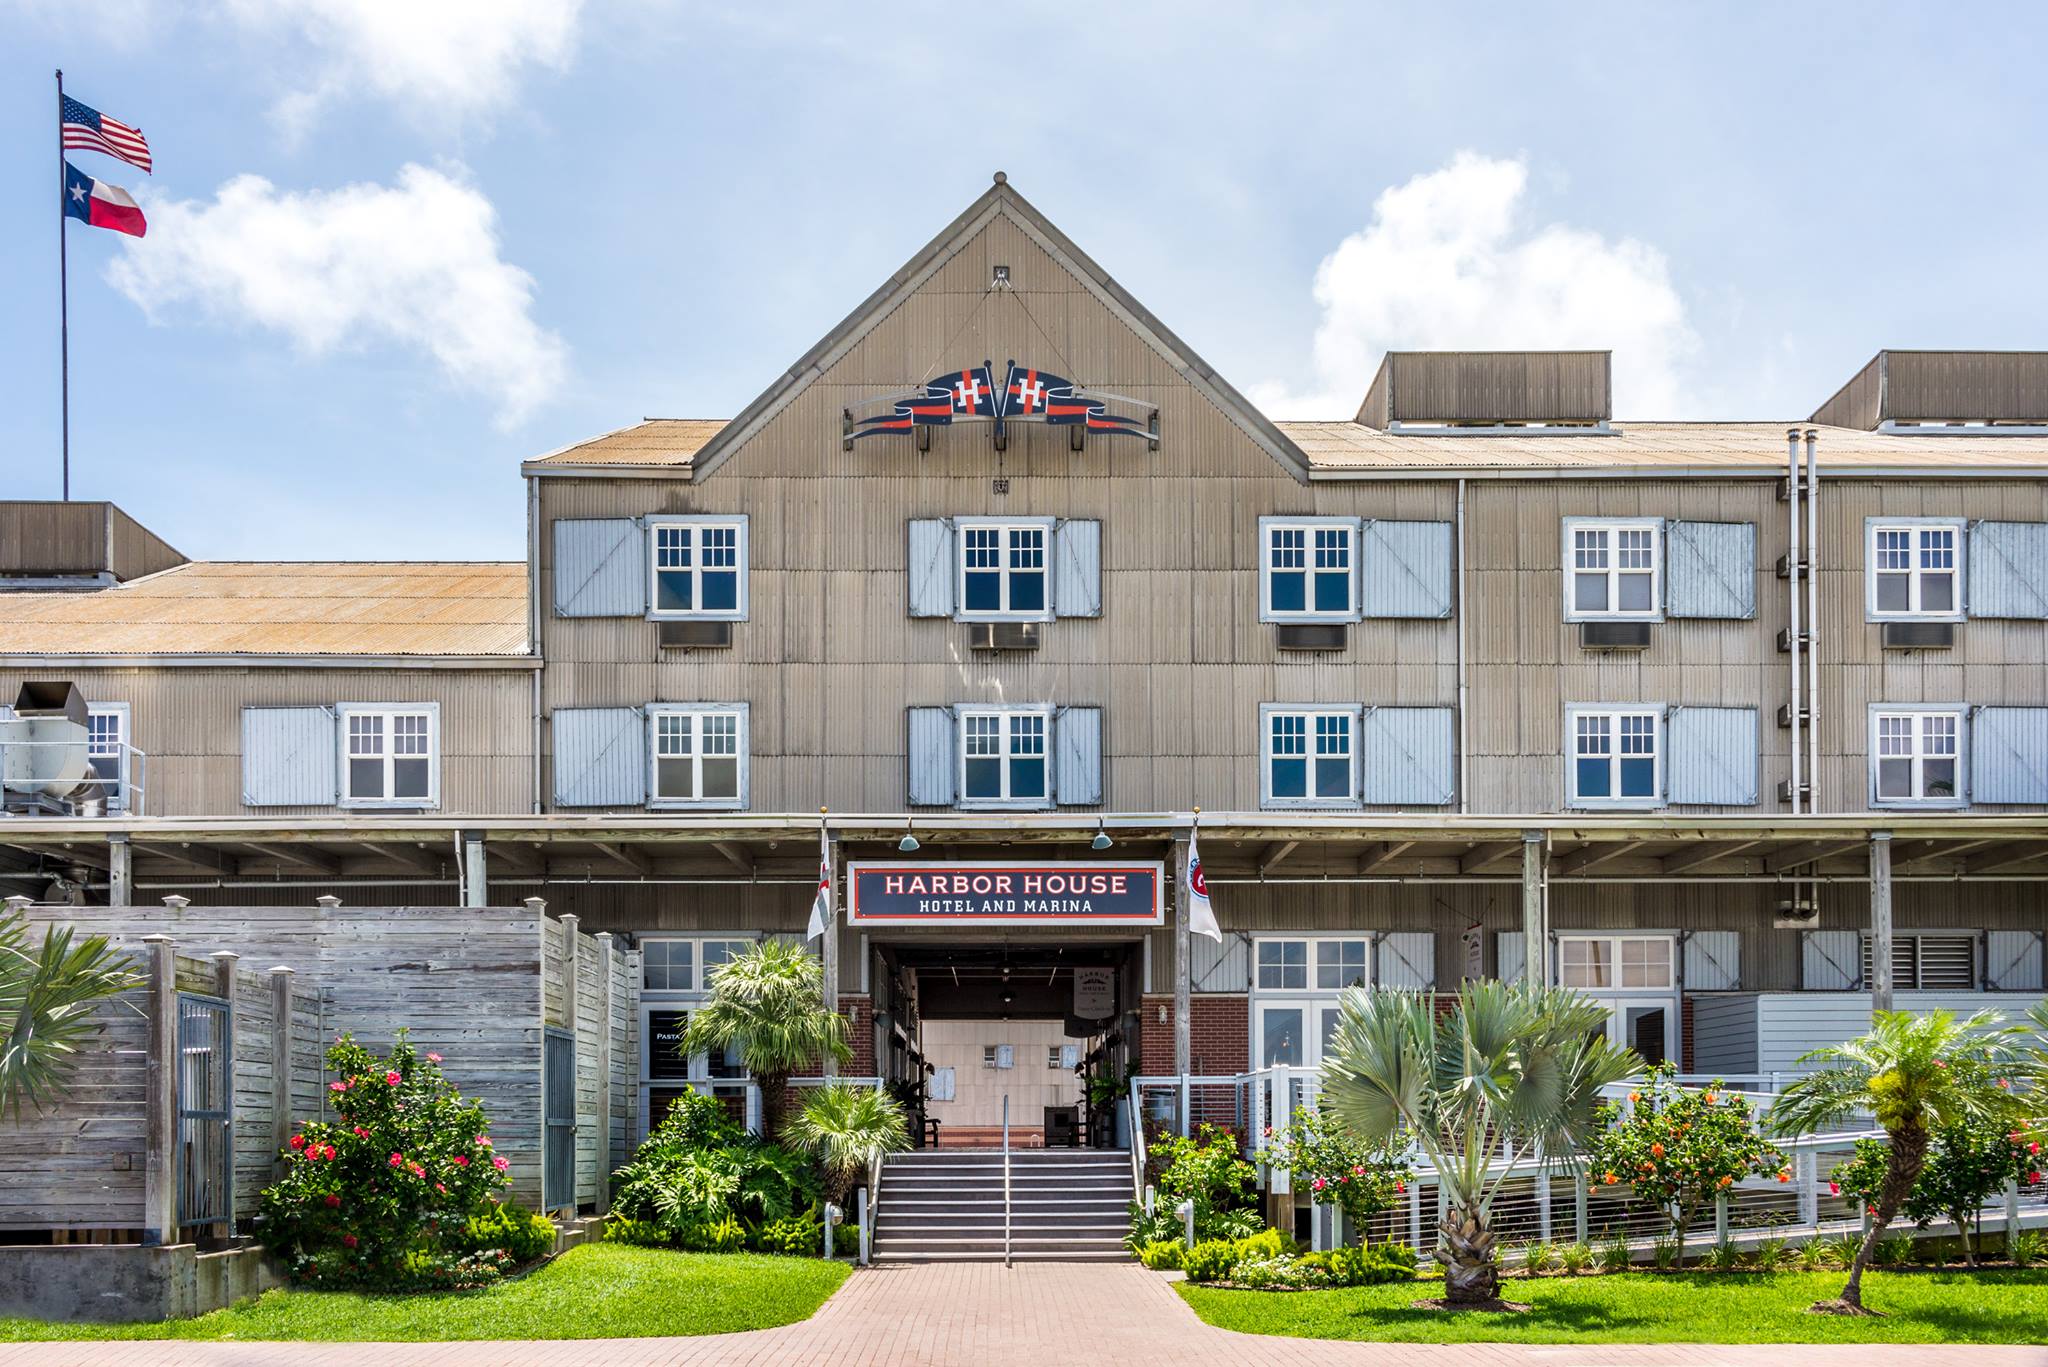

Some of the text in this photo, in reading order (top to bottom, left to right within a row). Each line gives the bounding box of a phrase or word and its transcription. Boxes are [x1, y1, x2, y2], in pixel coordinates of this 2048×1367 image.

[955, 378, 983, 407] H
[1016, 378, 1044, 407] H
[885, 875, 1128, 895] HARBOR HOUSE
[919, 899, 1093, 913] HOTEL AND MARINA
